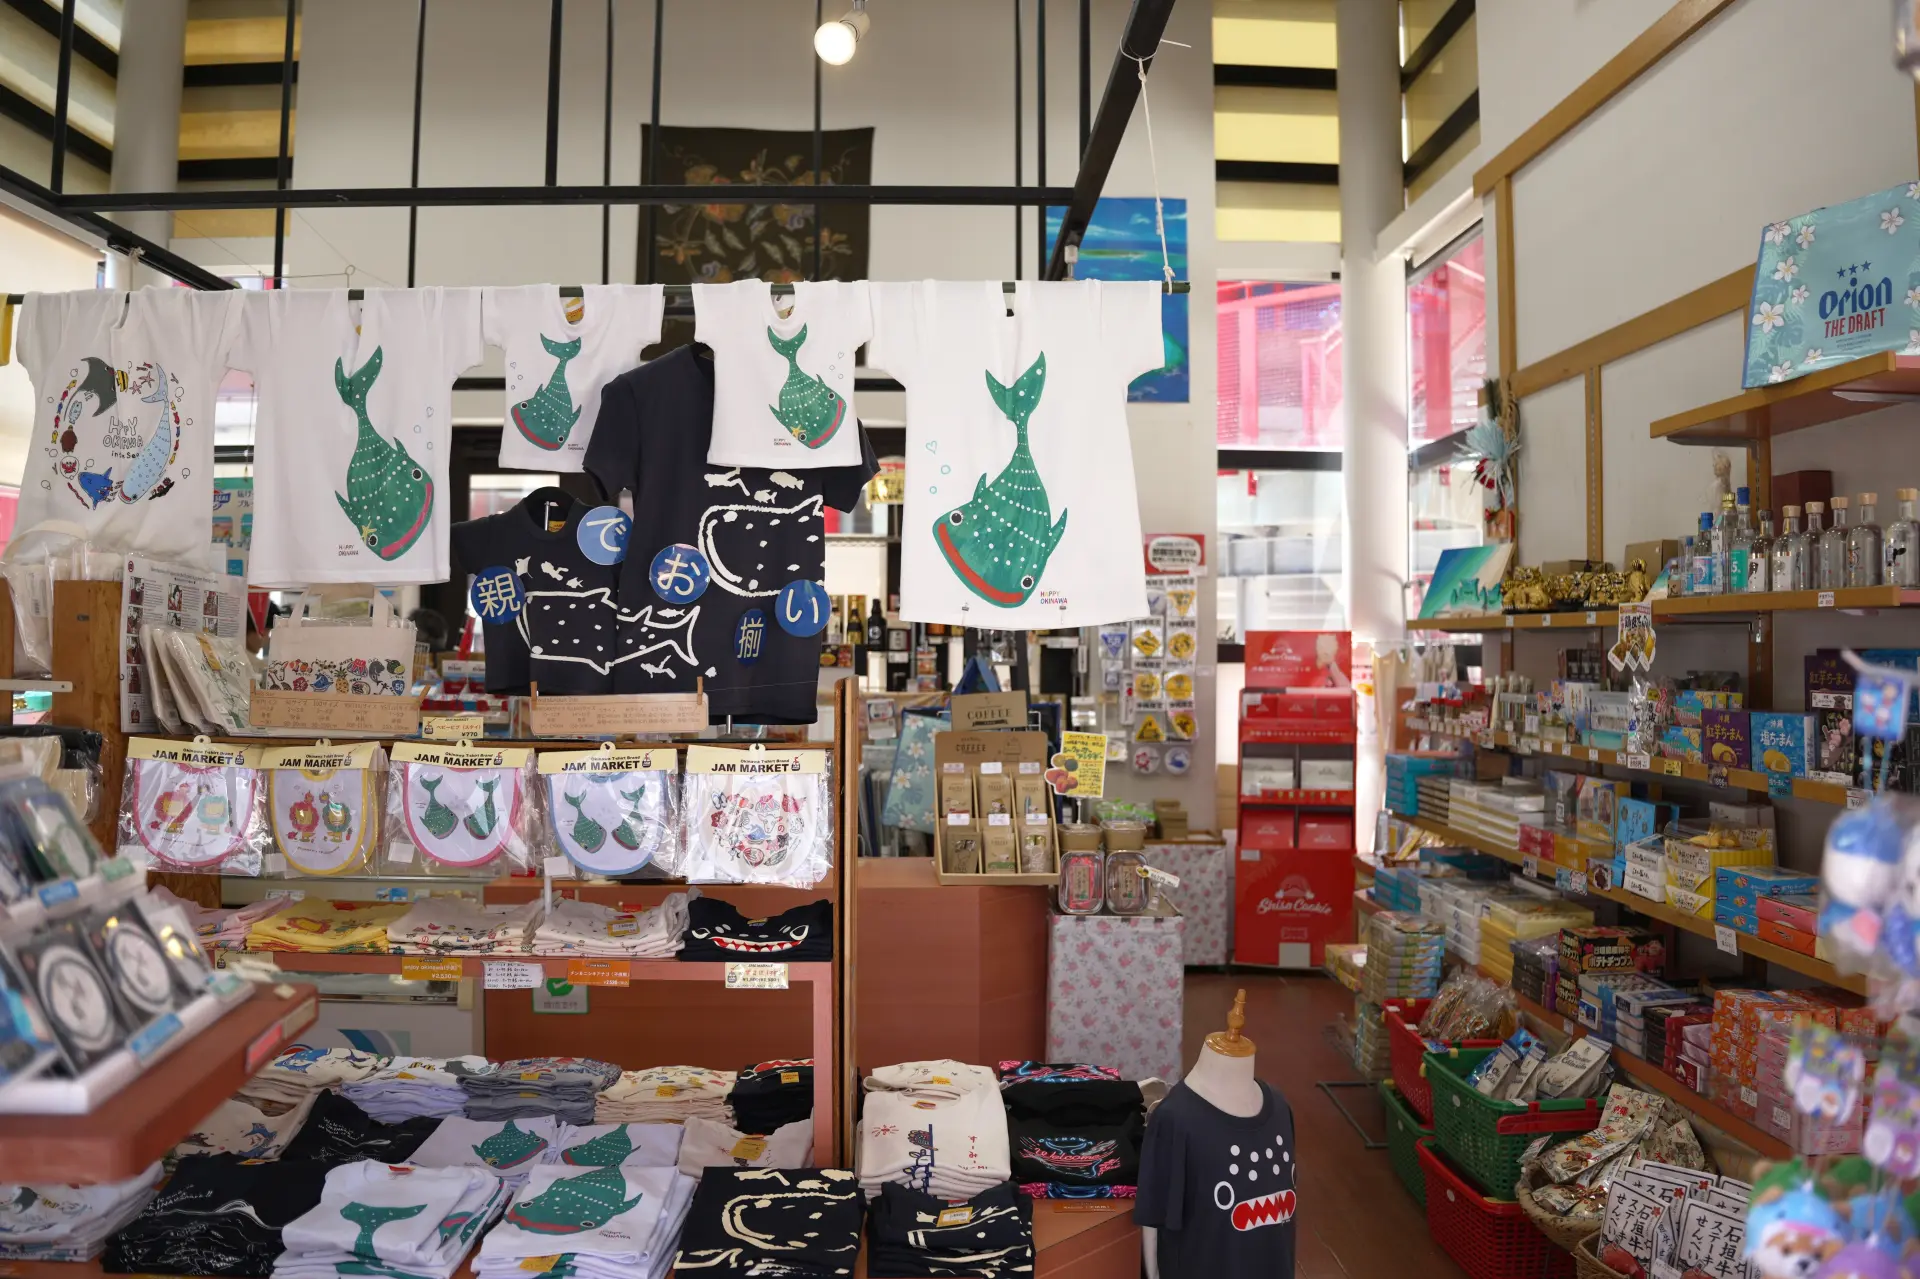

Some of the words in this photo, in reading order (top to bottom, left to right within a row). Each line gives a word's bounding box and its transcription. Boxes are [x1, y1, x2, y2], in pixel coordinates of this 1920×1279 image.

[1825, 317, 1846, 339] THE
[1848, 307, 1886, 335] DRAFT
[586, 517, 628, 552] で
[657, 553, 700, 595] お
[477, 572, 521, 619] 親
[785, 588, 819, 624] い
[737, 617, 764, 660] 揃
[967, 707, 1013, 721] COFFEE
[152, 750, 178, 760] JAM
[181, 753, 233, 765] MARKET
[279, 758, 302, 767] JAM
[304, 758, 343, 768] MARKET
[414, 753, 440, 763] JAM
[443, 756, 492, 767] MARKET
[561, 762, 587, 771] JAM
[590, 760, 640, 771] MARKET
[955, 744, 986, 753] COFFEE
[711, 763, 736, 772] JAM
[740, 764, 789, 773] MARKET
[1294, 898, 1332, 914] Cookie
[404, 964, 419, 972] enjoy
[1607, 1193, 1627, 1237] せんべい
[1617, 1199, 1639, 1243] ステーキ
[1628, 1203, 1652, 1252] 石垣牛
[1687, 1215, 1708, 1260] せんべい
[1703, 1220, 1723, 1265] ステーキ
[1715, 1226, 1743, 1278] 石垣牛
